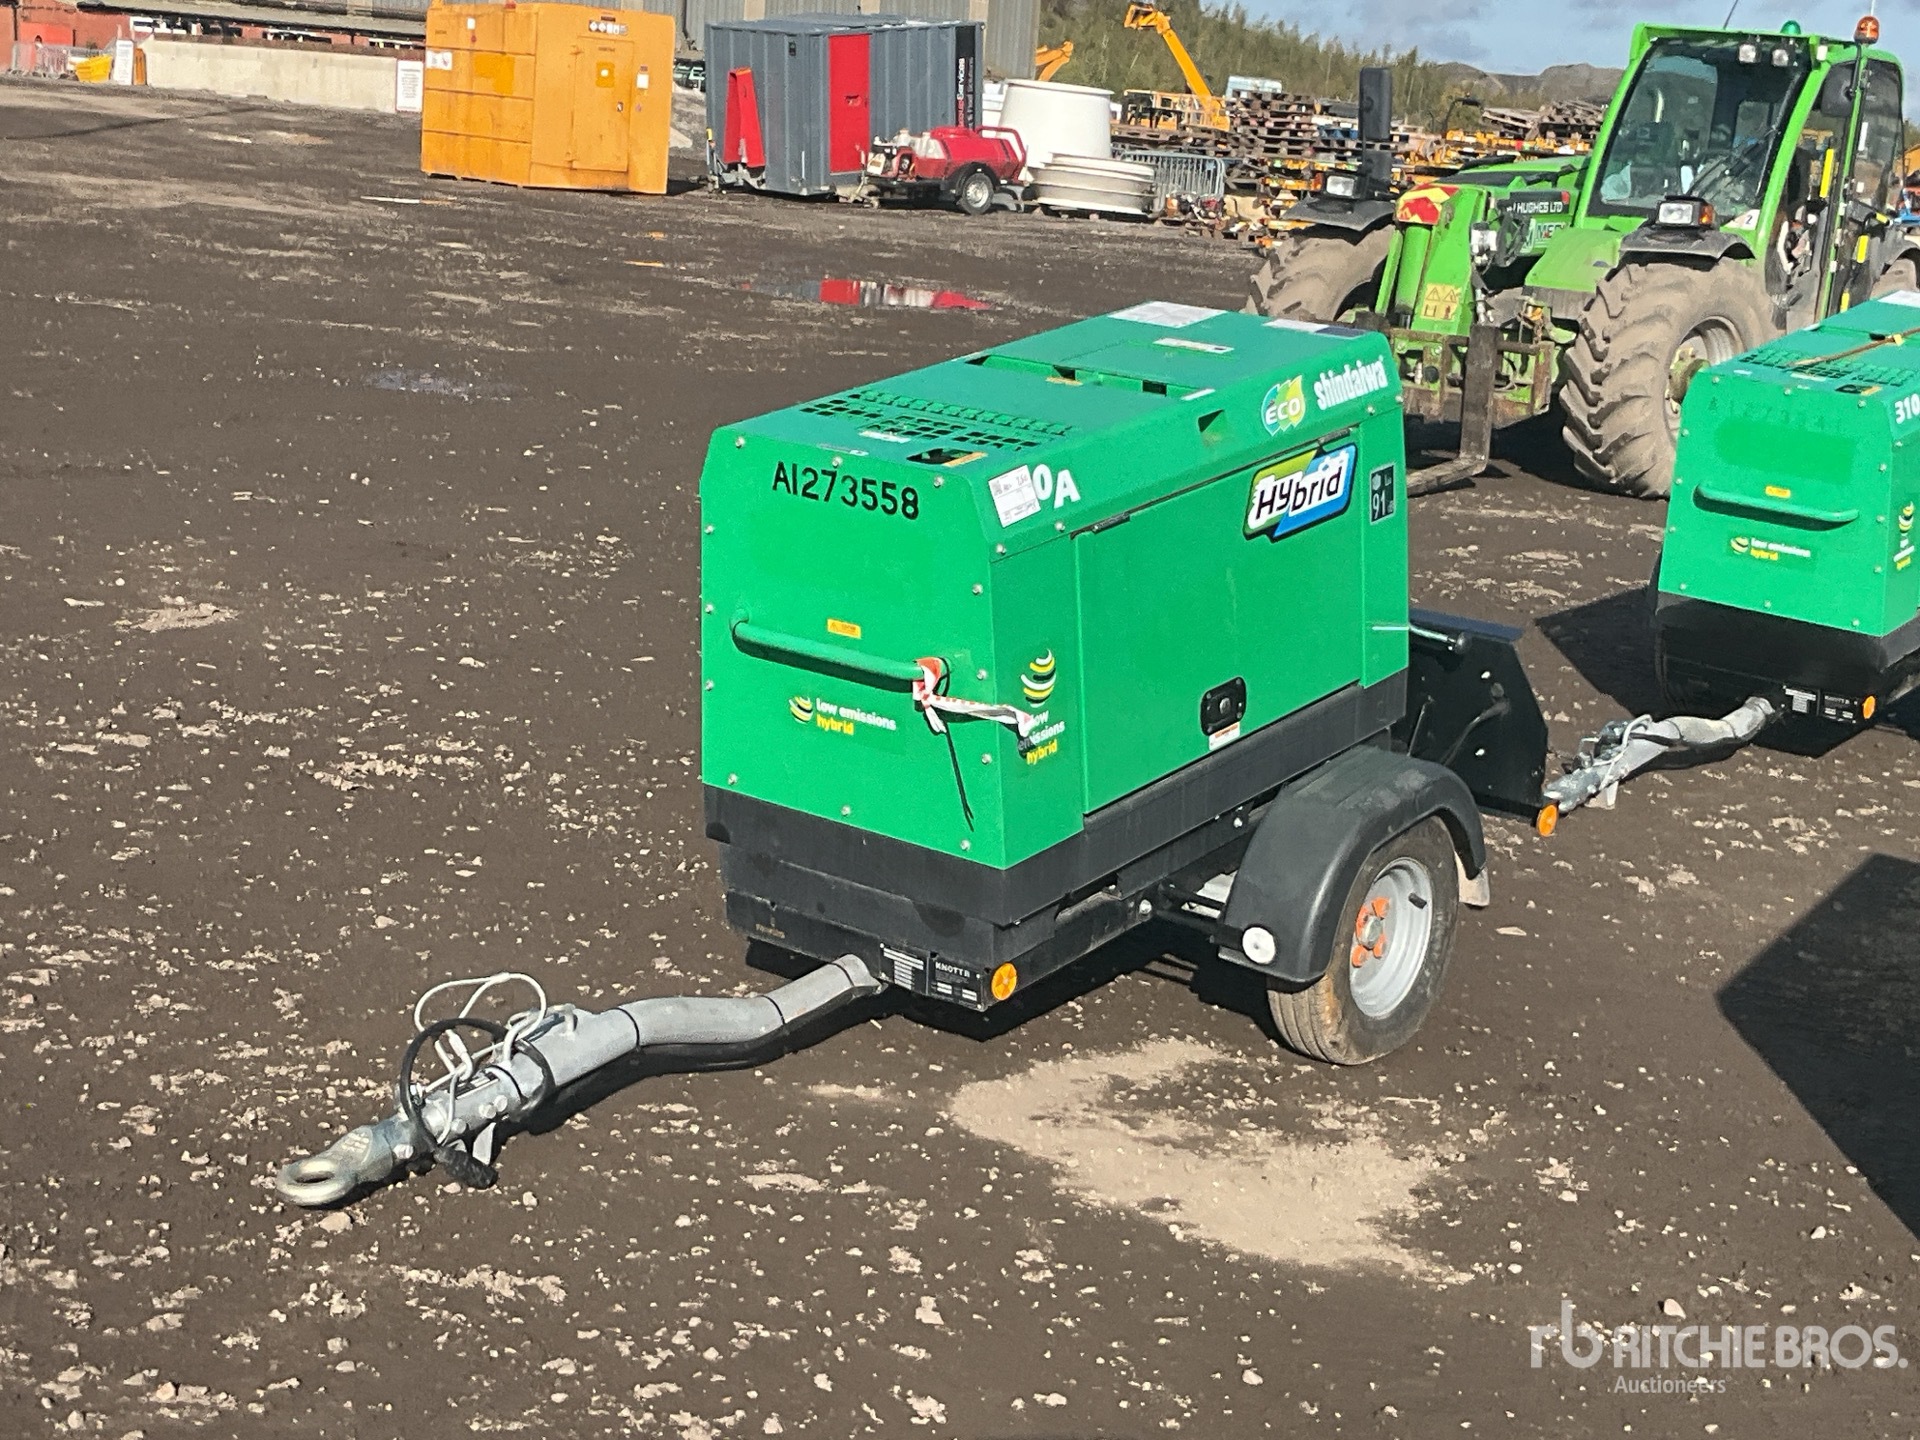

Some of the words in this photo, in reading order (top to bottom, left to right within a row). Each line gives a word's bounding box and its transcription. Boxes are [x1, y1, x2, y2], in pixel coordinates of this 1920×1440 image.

[1517, 202, 1549, 214] HUGHES
[1550, 201, 1564, 213] LTD
[1314, 358, 1388, 410] shindaiwa
[1265, 398, 1301, 425] ECO
[1255, 465, 1343, 520] Hybrid
[1373, 489, 1386, 520] 91
[816, 698, 838, 716] low
[838, 706, 897, 731] emissions
[816, 713, 854, 736] hybrid
[1026, 738, 1058, 766] hybrid
